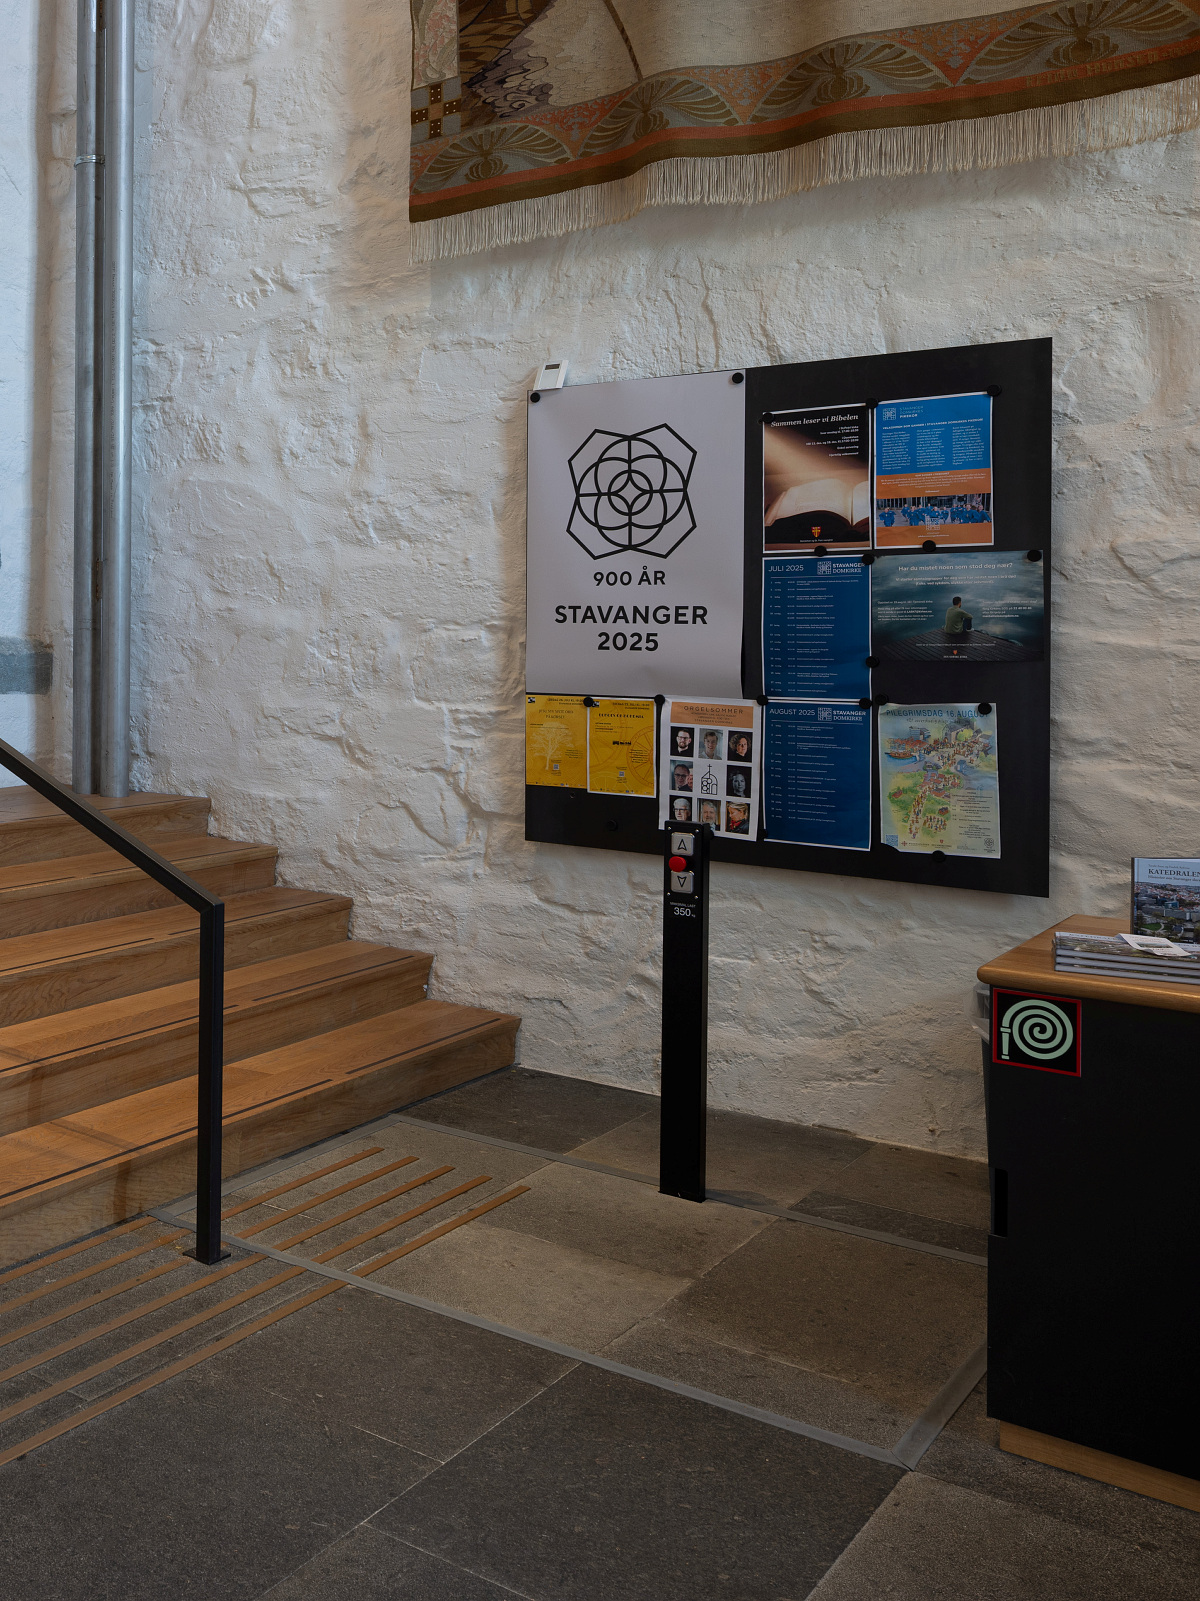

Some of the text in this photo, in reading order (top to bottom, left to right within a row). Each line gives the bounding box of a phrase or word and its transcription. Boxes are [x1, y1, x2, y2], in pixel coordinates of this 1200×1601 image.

[830, 414, 858, 422] Bibelen
[593, 566, 666, 586] 900 ÅR
[554, 605, 708, 624] STAVANGER
[598, 632, 658, 651] 2025
[684, 706, 744, 714] ORGELSOMMER
[946, 710, 989, 718] 16.AUGU
[674, 907, 691, 916] 350
